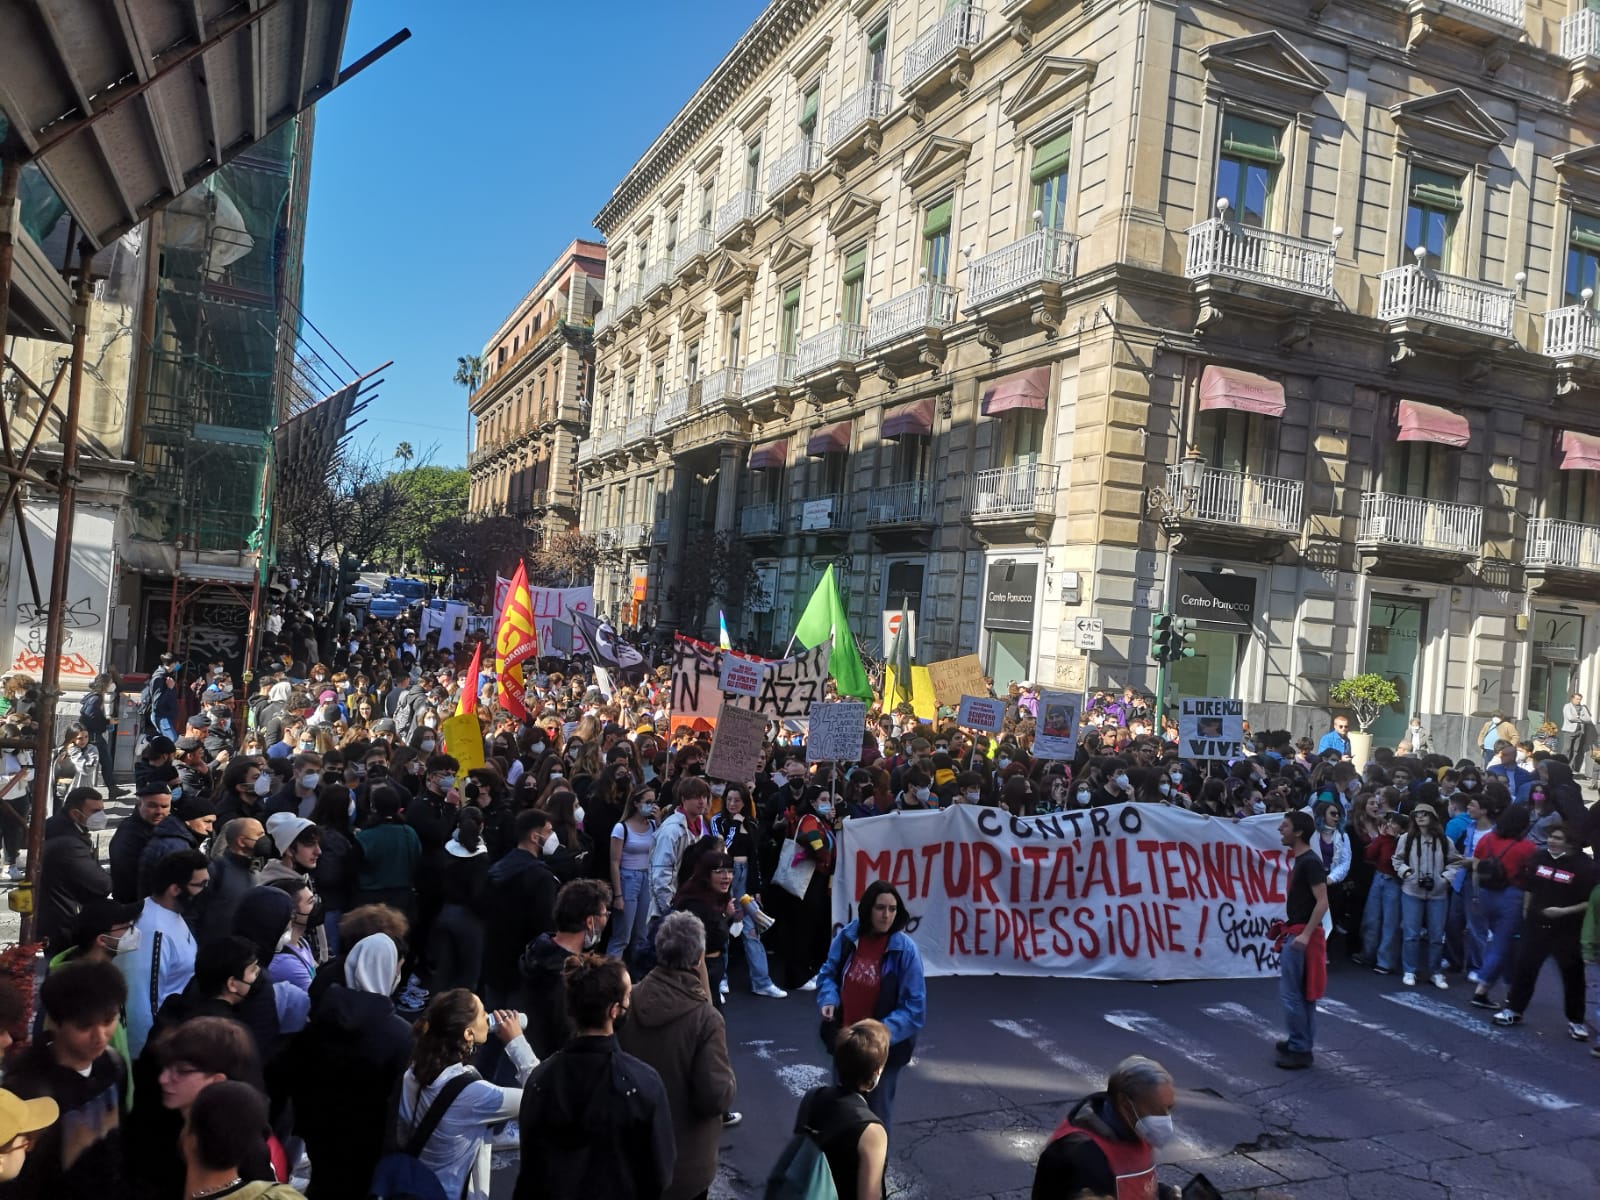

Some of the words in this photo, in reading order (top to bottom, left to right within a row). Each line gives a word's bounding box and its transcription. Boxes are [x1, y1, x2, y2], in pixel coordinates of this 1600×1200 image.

[988, 591, 1007, 602] Centro
[1181, 594, 1211, 607] Centro
[1212, 597, 1250, 611] Parrucca
[1081, 639, 1096, 647] Hotel
[1083, 633, 1094, 641] City
[671, 672, 699, 711] IN
[1183, 701, 1242, 715] LORENZO
[1189, 739, 1240, 757] VIVE
[978, 806, 1142, 839] CONTRO
